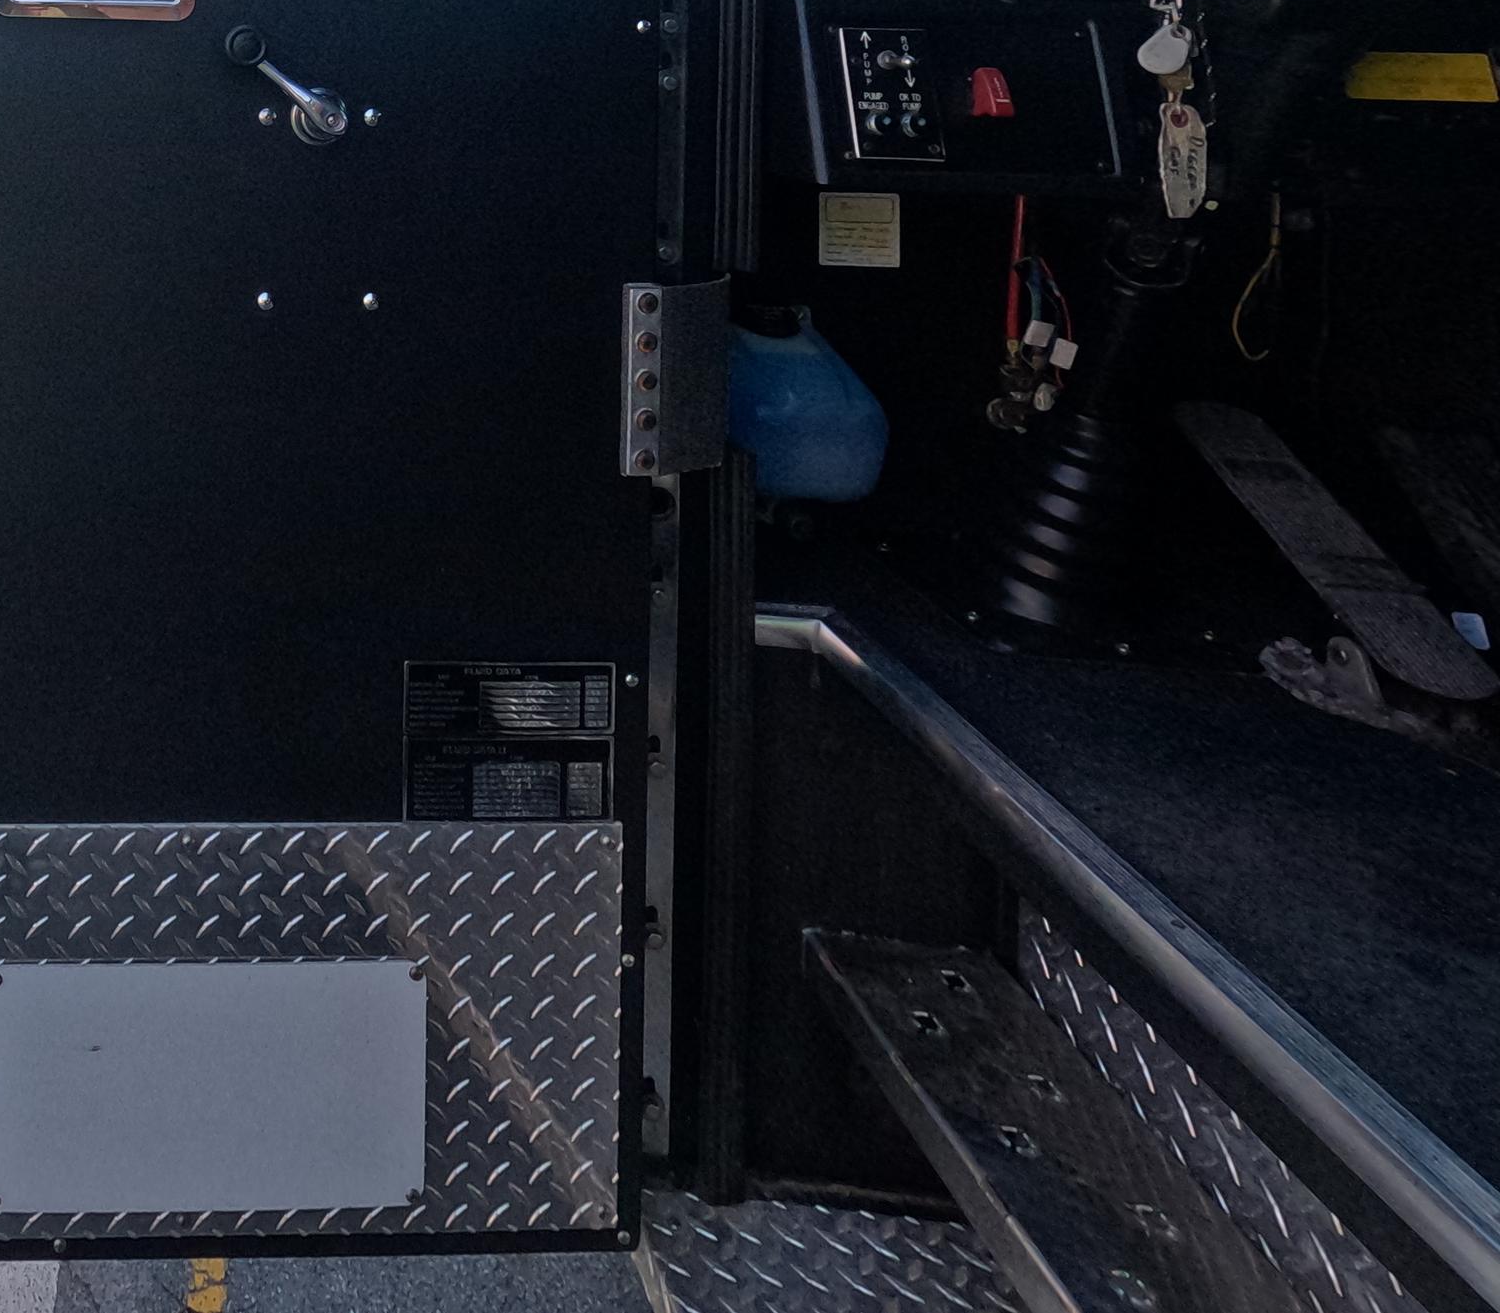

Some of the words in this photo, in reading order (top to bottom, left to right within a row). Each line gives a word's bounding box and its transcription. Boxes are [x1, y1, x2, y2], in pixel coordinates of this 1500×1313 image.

[862, 52, 873, 86] PUMP
[863, 91, 884, 101] PUMP
[898, 92, 910, 101] OK
[911, 93, 922, 102] TO
[857, 101, 890, 111] ENGAGED
[901, 102, 922, 112] PUMP
[463, 667, 493, 676] FLUID
[495, 667, 522, 676] DATA
